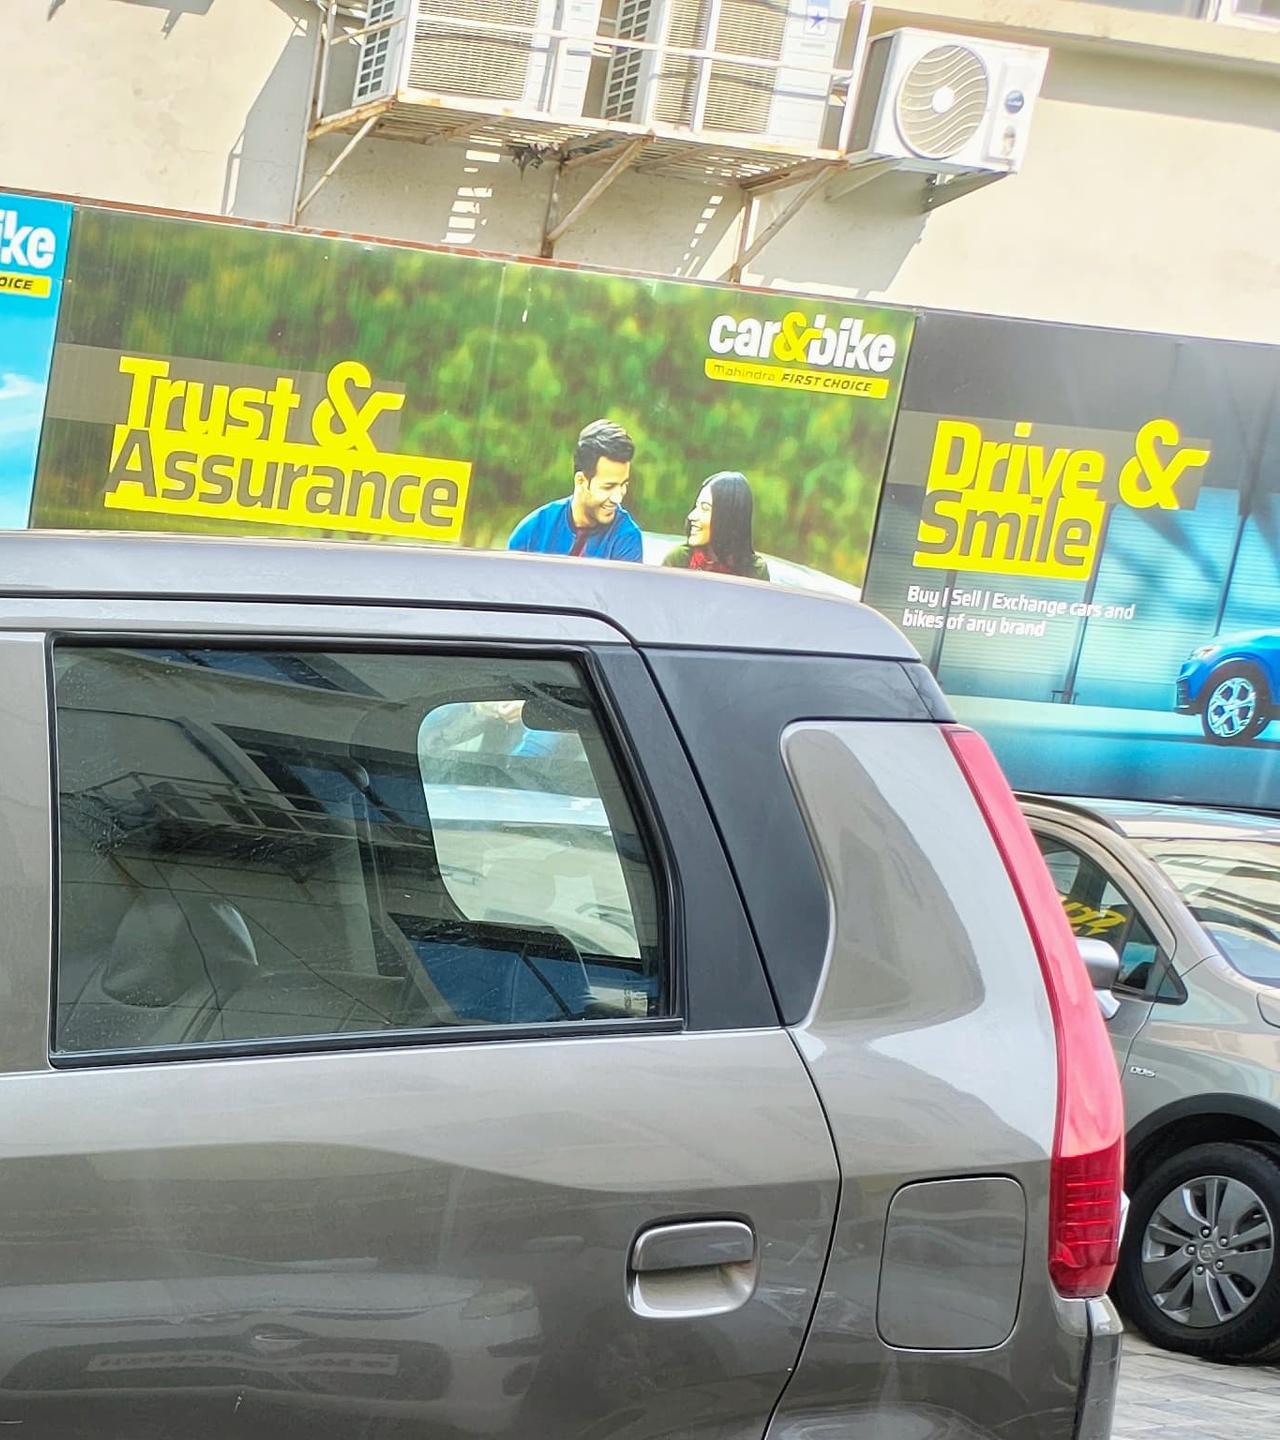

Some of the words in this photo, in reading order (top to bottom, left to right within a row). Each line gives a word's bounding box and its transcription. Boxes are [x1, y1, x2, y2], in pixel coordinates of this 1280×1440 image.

[709, 311, 896, 373] car&bike
[119, 356, 300, 443] Trust
[312, 361, 406, 454] &
[780, 373, 821, 387] FIRST
[822, 378, 873, 393] CHOICE
[105, 430, 459, 527] Assurance
[926, 420, 1106, 500] Drive
[1118, 419, 1210, 510] &
[917, 489, 1091, 566] Smile
[902, 608, 945, 629] bikes
[946, 613, 965, 630] of
[966, 618, 998, 637] any
[999, 617, 1045, 637] brand
[907, 585, 942, 609] Buy
[950, 589, 981, 608] Sell
[992, 594, 1068, 617] Exchange
[1069, 602, 1102, 617] cars
[1104, 604, 1135, 620] and
